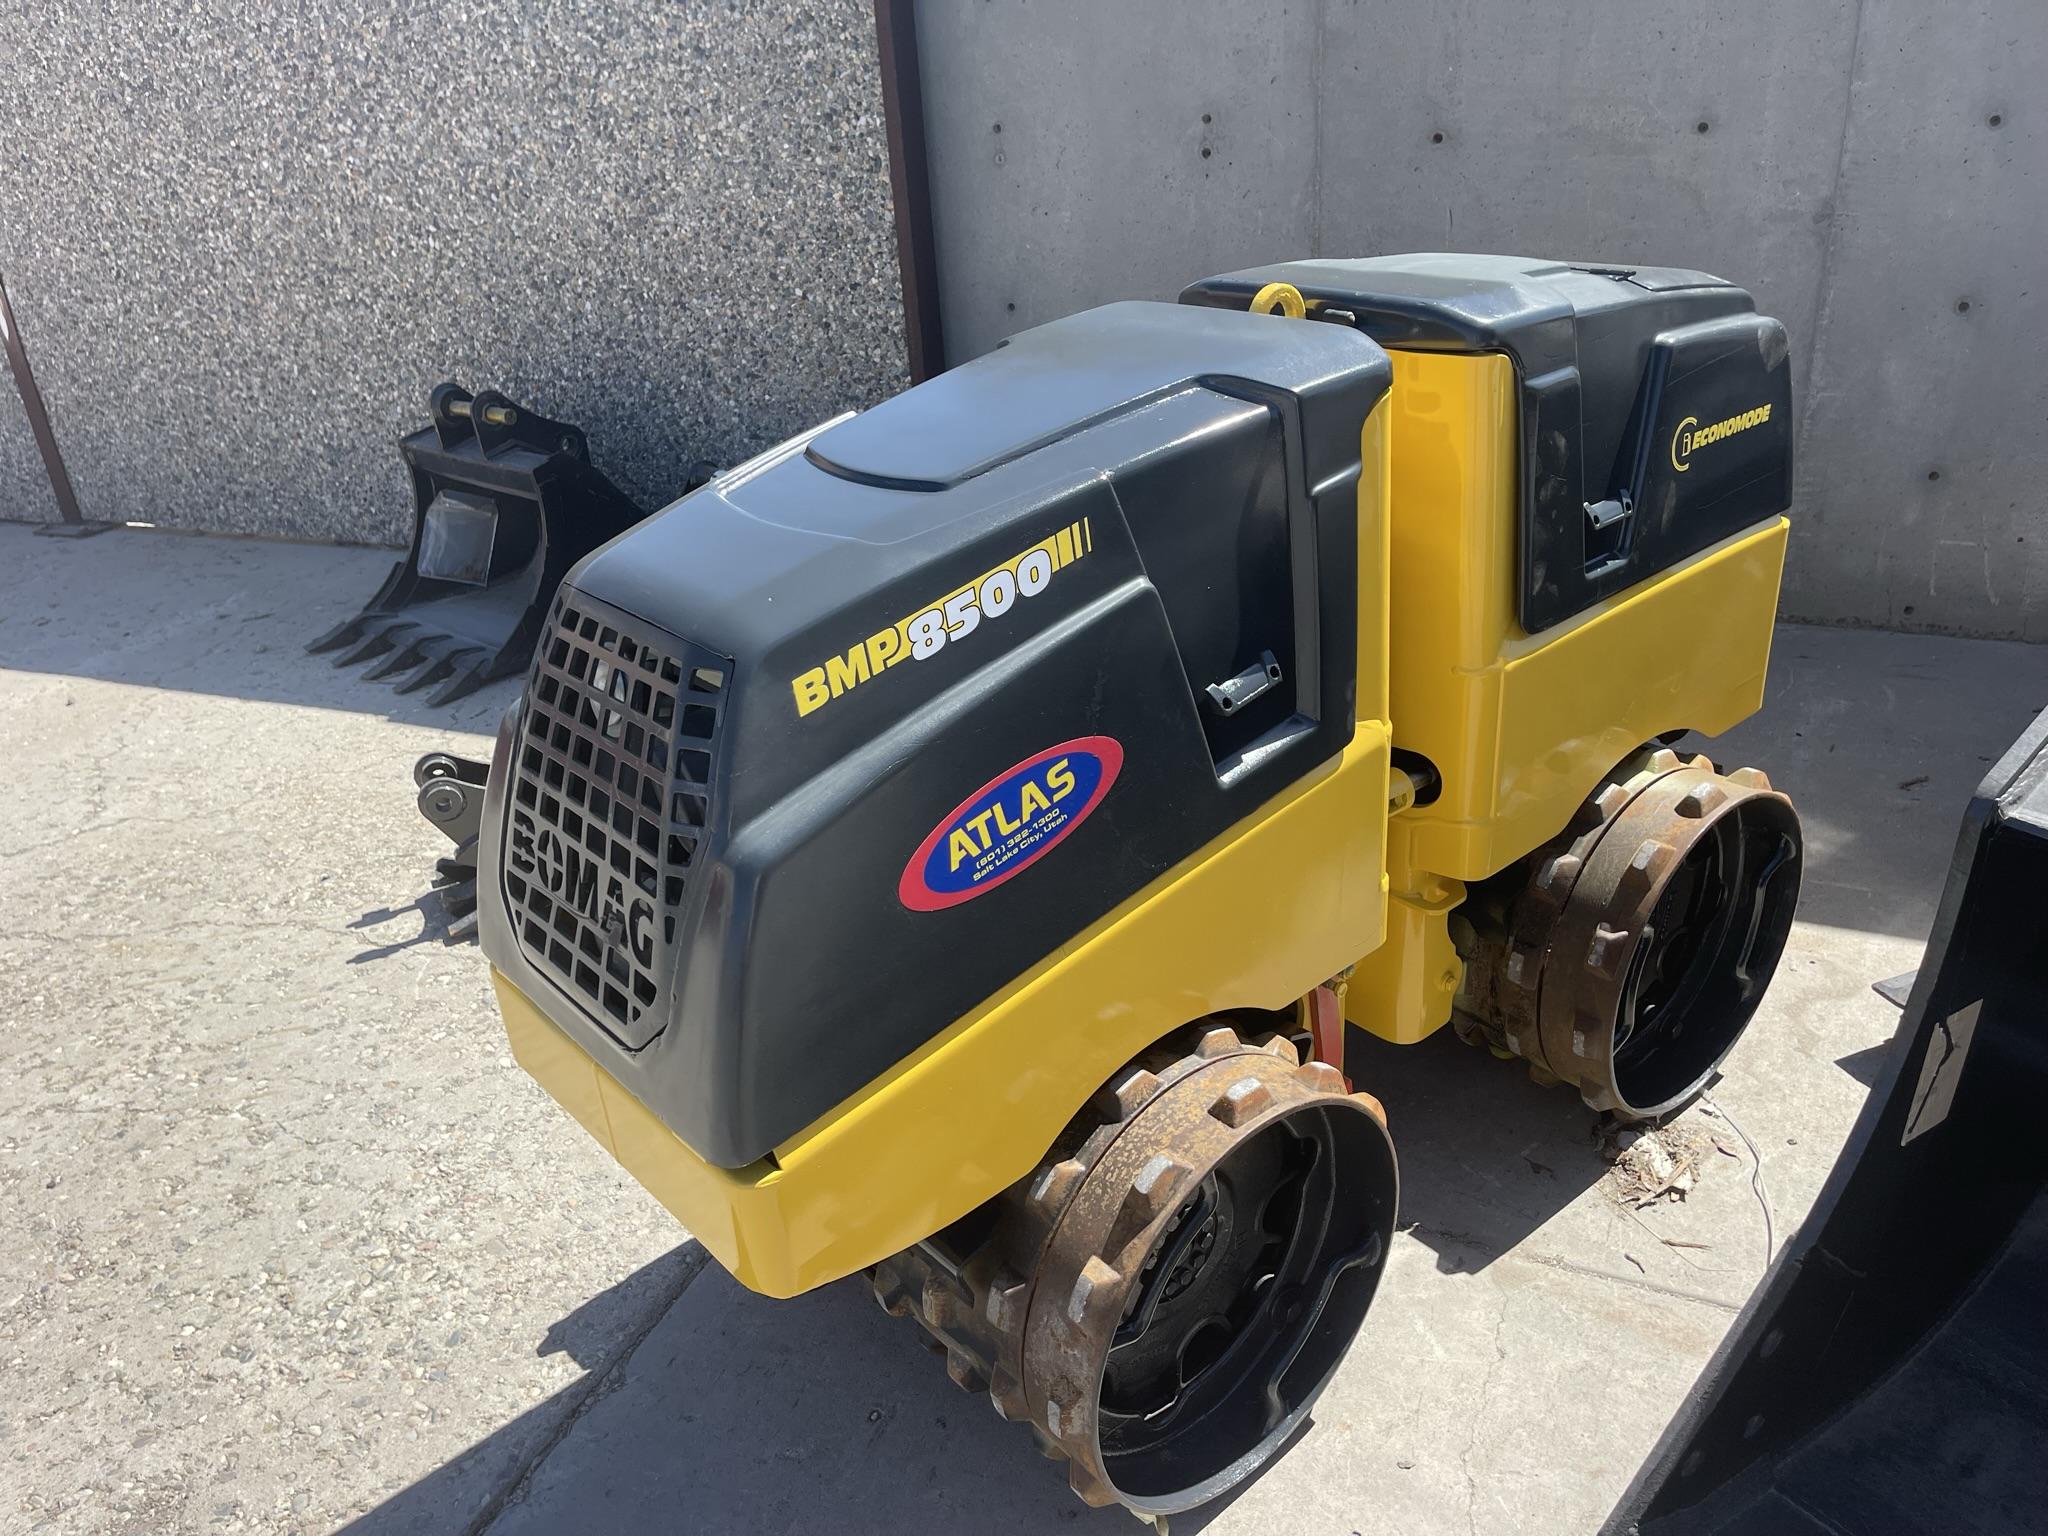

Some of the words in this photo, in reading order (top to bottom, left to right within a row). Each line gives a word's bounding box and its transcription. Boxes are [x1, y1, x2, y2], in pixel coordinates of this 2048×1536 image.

[949, 757, 1076, 873] ATLAS
[972, 863, 995, 881] Salt
[995, 847, 1019, 866] Lake
[1020, 831, 1043, 849] City,
[1043, 813, 1068, 833] Utah
[1006, 807, 1060, 848] 322-1300
[511, 808, 655, 970] BOMAG
